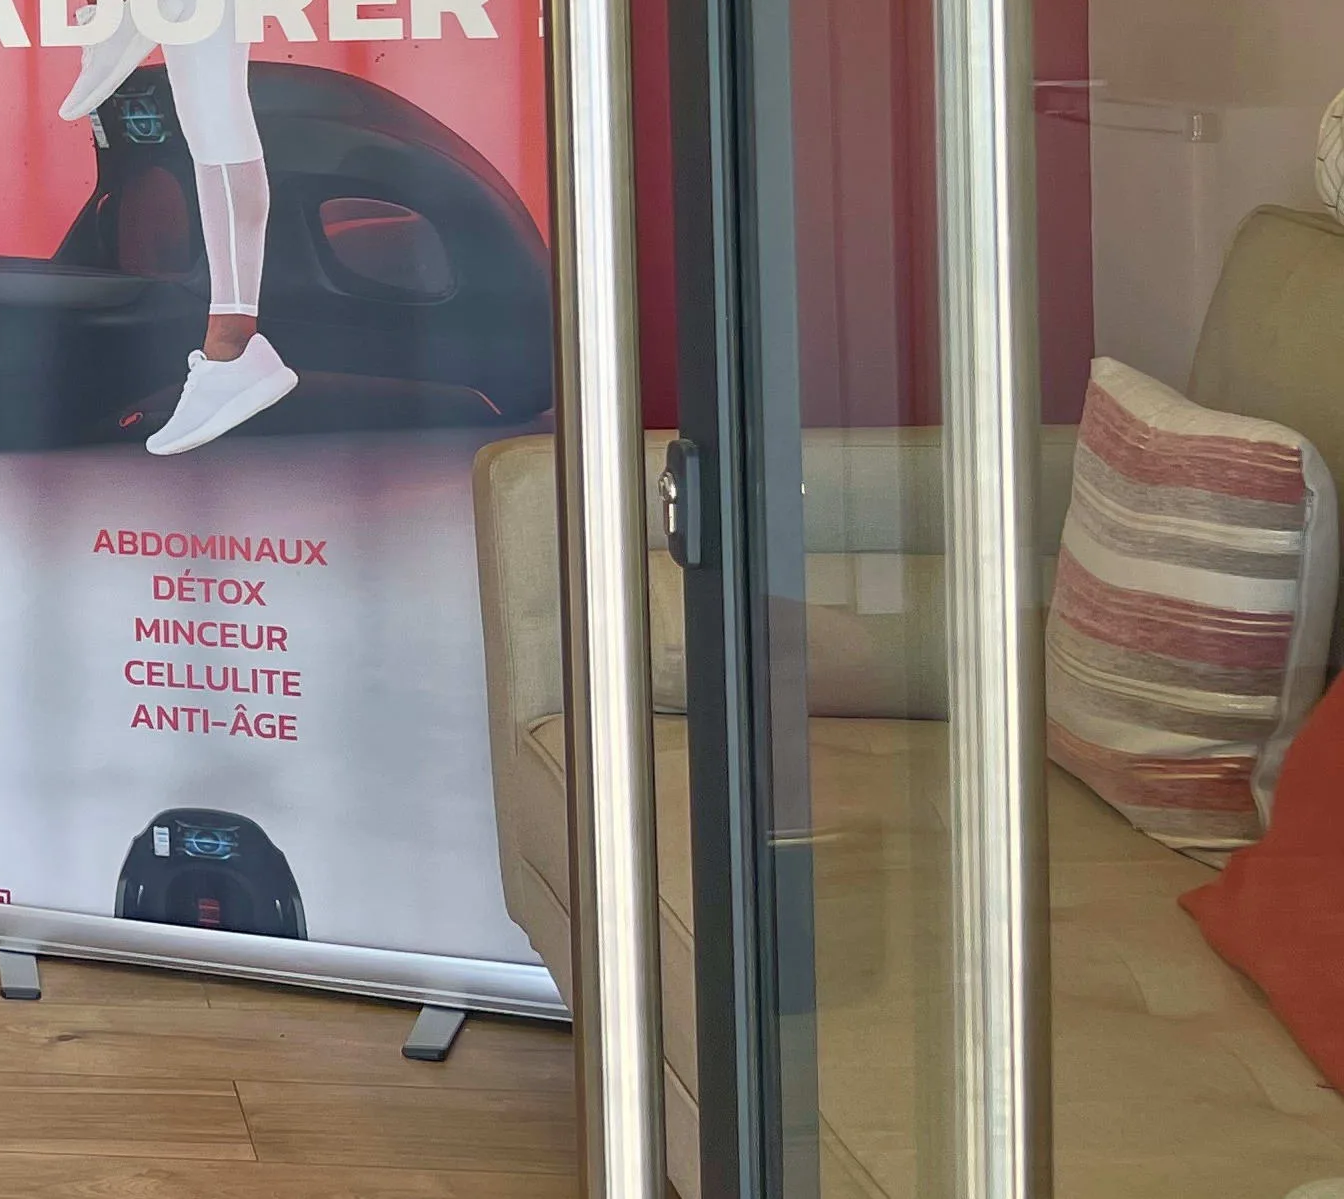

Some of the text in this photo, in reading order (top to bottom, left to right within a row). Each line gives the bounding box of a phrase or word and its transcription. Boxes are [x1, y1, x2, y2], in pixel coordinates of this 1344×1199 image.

[93, 529, 328, 567] ABDOMINAUX
[152, 568, 267, 607] DÉTOX
[135, 617, 288, 652] MINCEUR
[124, 660, 302, 697] CELLULITE
[130, 703, 298, 741] ANTI-ÂGE
